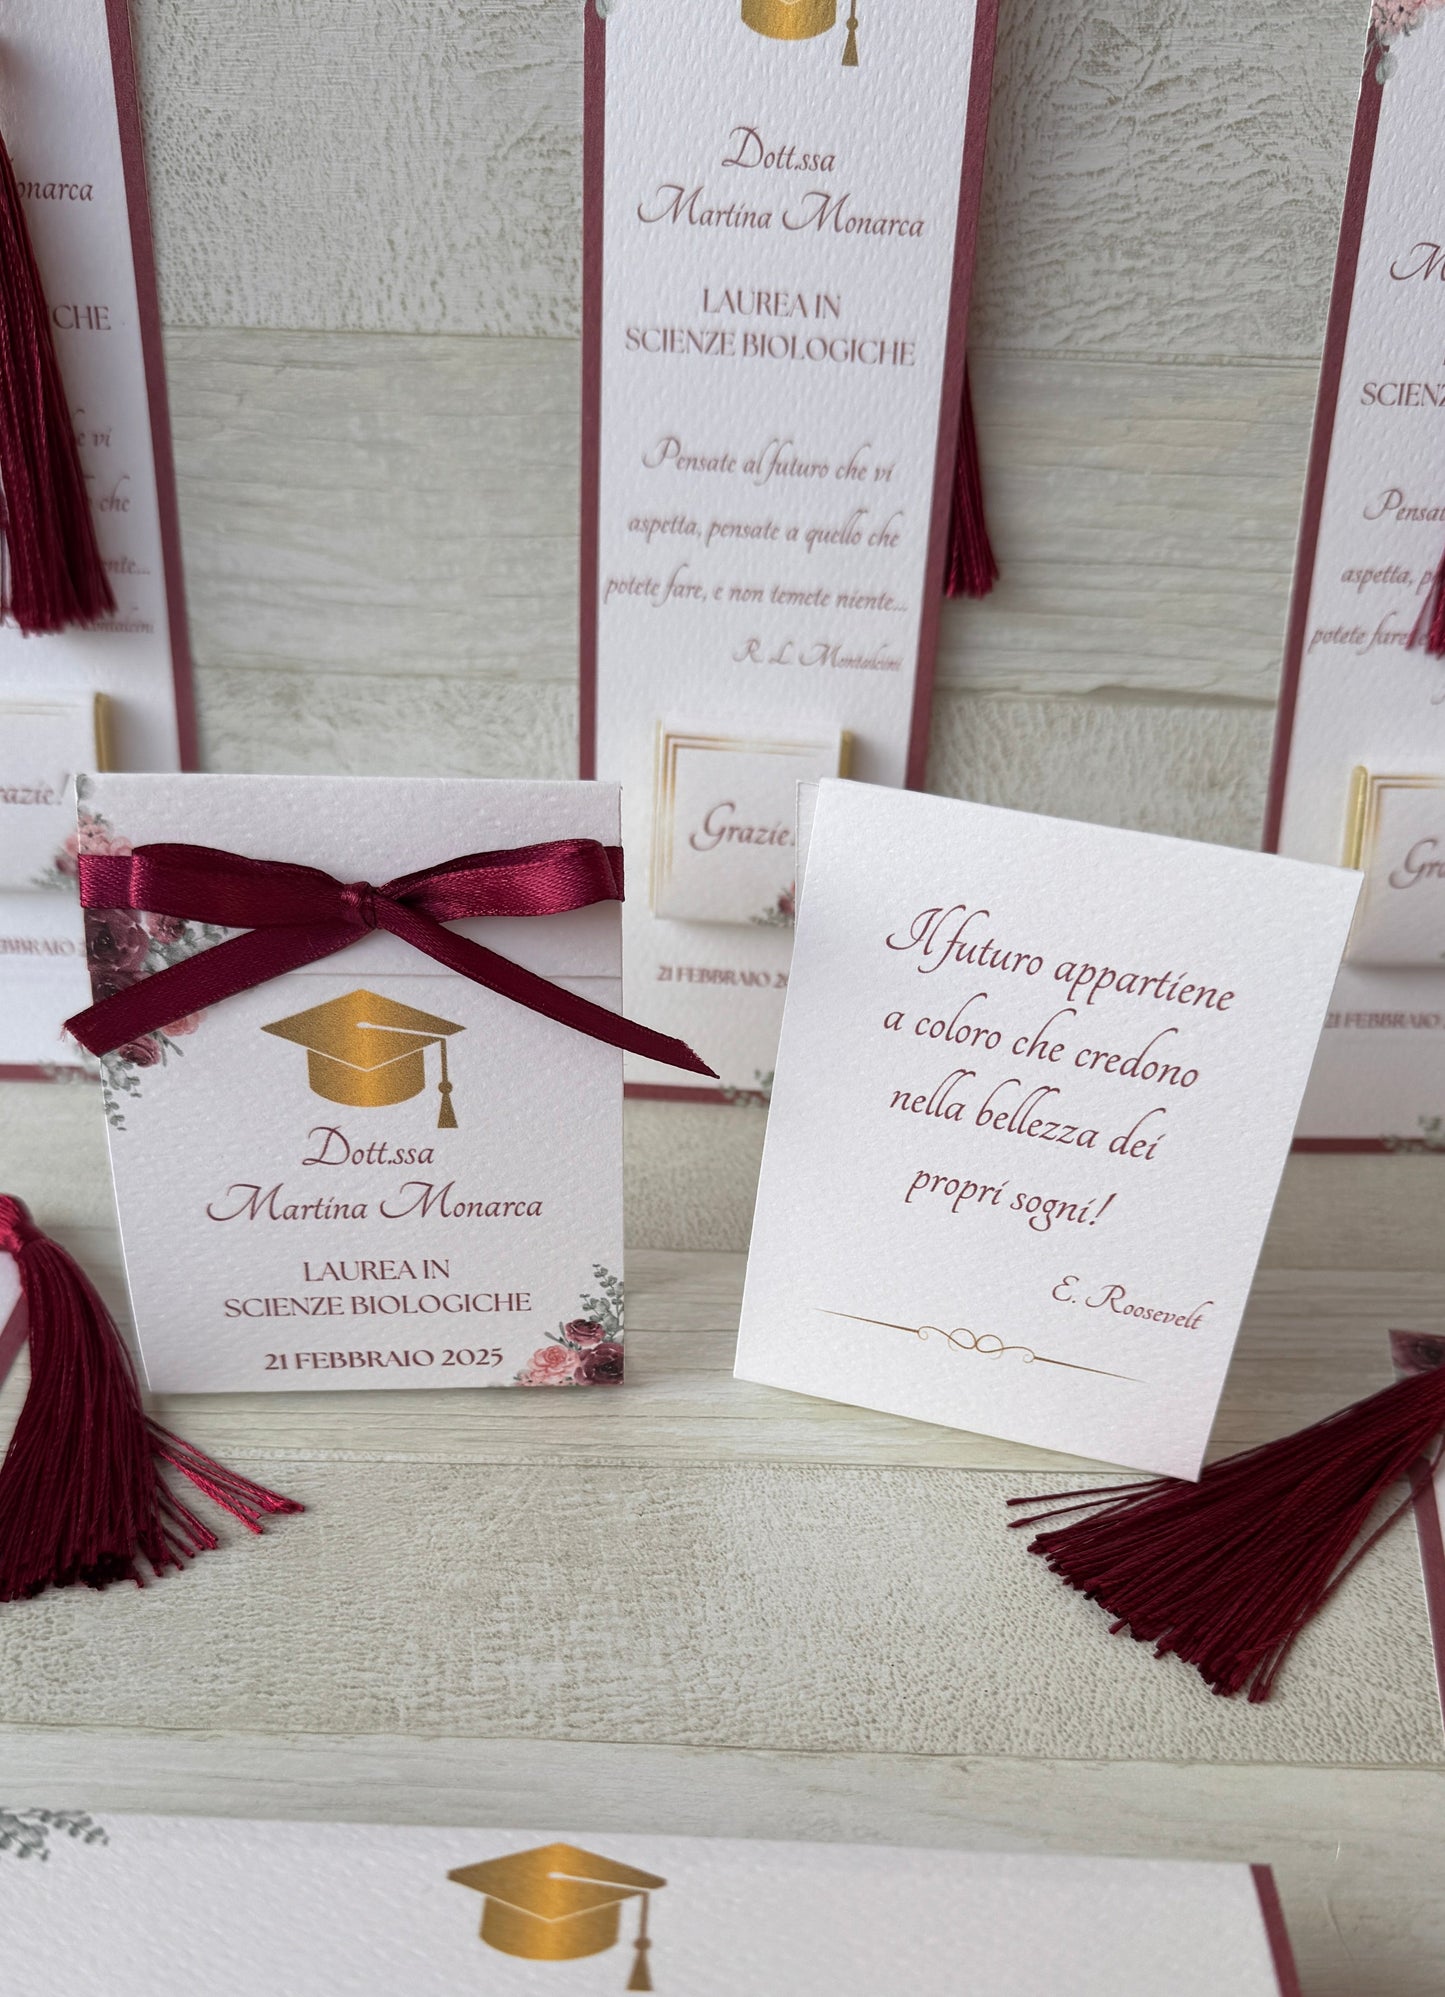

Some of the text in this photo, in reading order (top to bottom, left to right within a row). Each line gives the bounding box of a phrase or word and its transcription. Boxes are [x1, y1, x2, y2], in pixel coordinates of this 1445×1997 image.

[721, 126, 836, 172] Dott.ssa
[16, 181, 95, 202] onarca
[637, 184, 925, 238] Martina Monarca
[703, 288, 841, 319] LAUREA IN
[625, 327, 916, 367] SCIENZE BIOLOGICHE
[1360, 382, 1445, 407] SCIEN
[641, 435, 737, 475] Pensate
[753, 440, 829, 487] futuro
[834, 443, 872, 482] che
[872, 462, 896, 484] vi
[704, 520, 780, 548] pensate
[786, 527, 799, 543] a
[804, 508, 868, 554] quello
[867, 510, 905, 549] che
[603, 574, 661, 606] potete
[651, 562, 708, 608] fare,
[713, 585, 723, 601] e
[728, 586, 764, 603] non
[769, 584, 831, 608] temete
[1308, 626, 1367, 655] potete
[676, 966, 771, 988] FEBBRAIO
[886, 905, 1236, 1012] Il futuro appartiene
[883, 992, 1200, 1088] a coloro che credono
[889, 1068, 1167, 1161] nella bellezza dei
[302, 1125, 435, 1167] Dott.ssa
[206, 1180, 544, 1222] Martina Monarca
[904, 1169, 1118, 1232] propri sogni!
[302, 1258, 451, 1283] LAUREA IN
[223, 1292, 533, 1319] SCIENZE BIOLOGICHE
[1052, 1275, 1213, 1330] E. Roosevelt
[264, 1347, 505, 1371] 21 FEBBRAIO 2025
